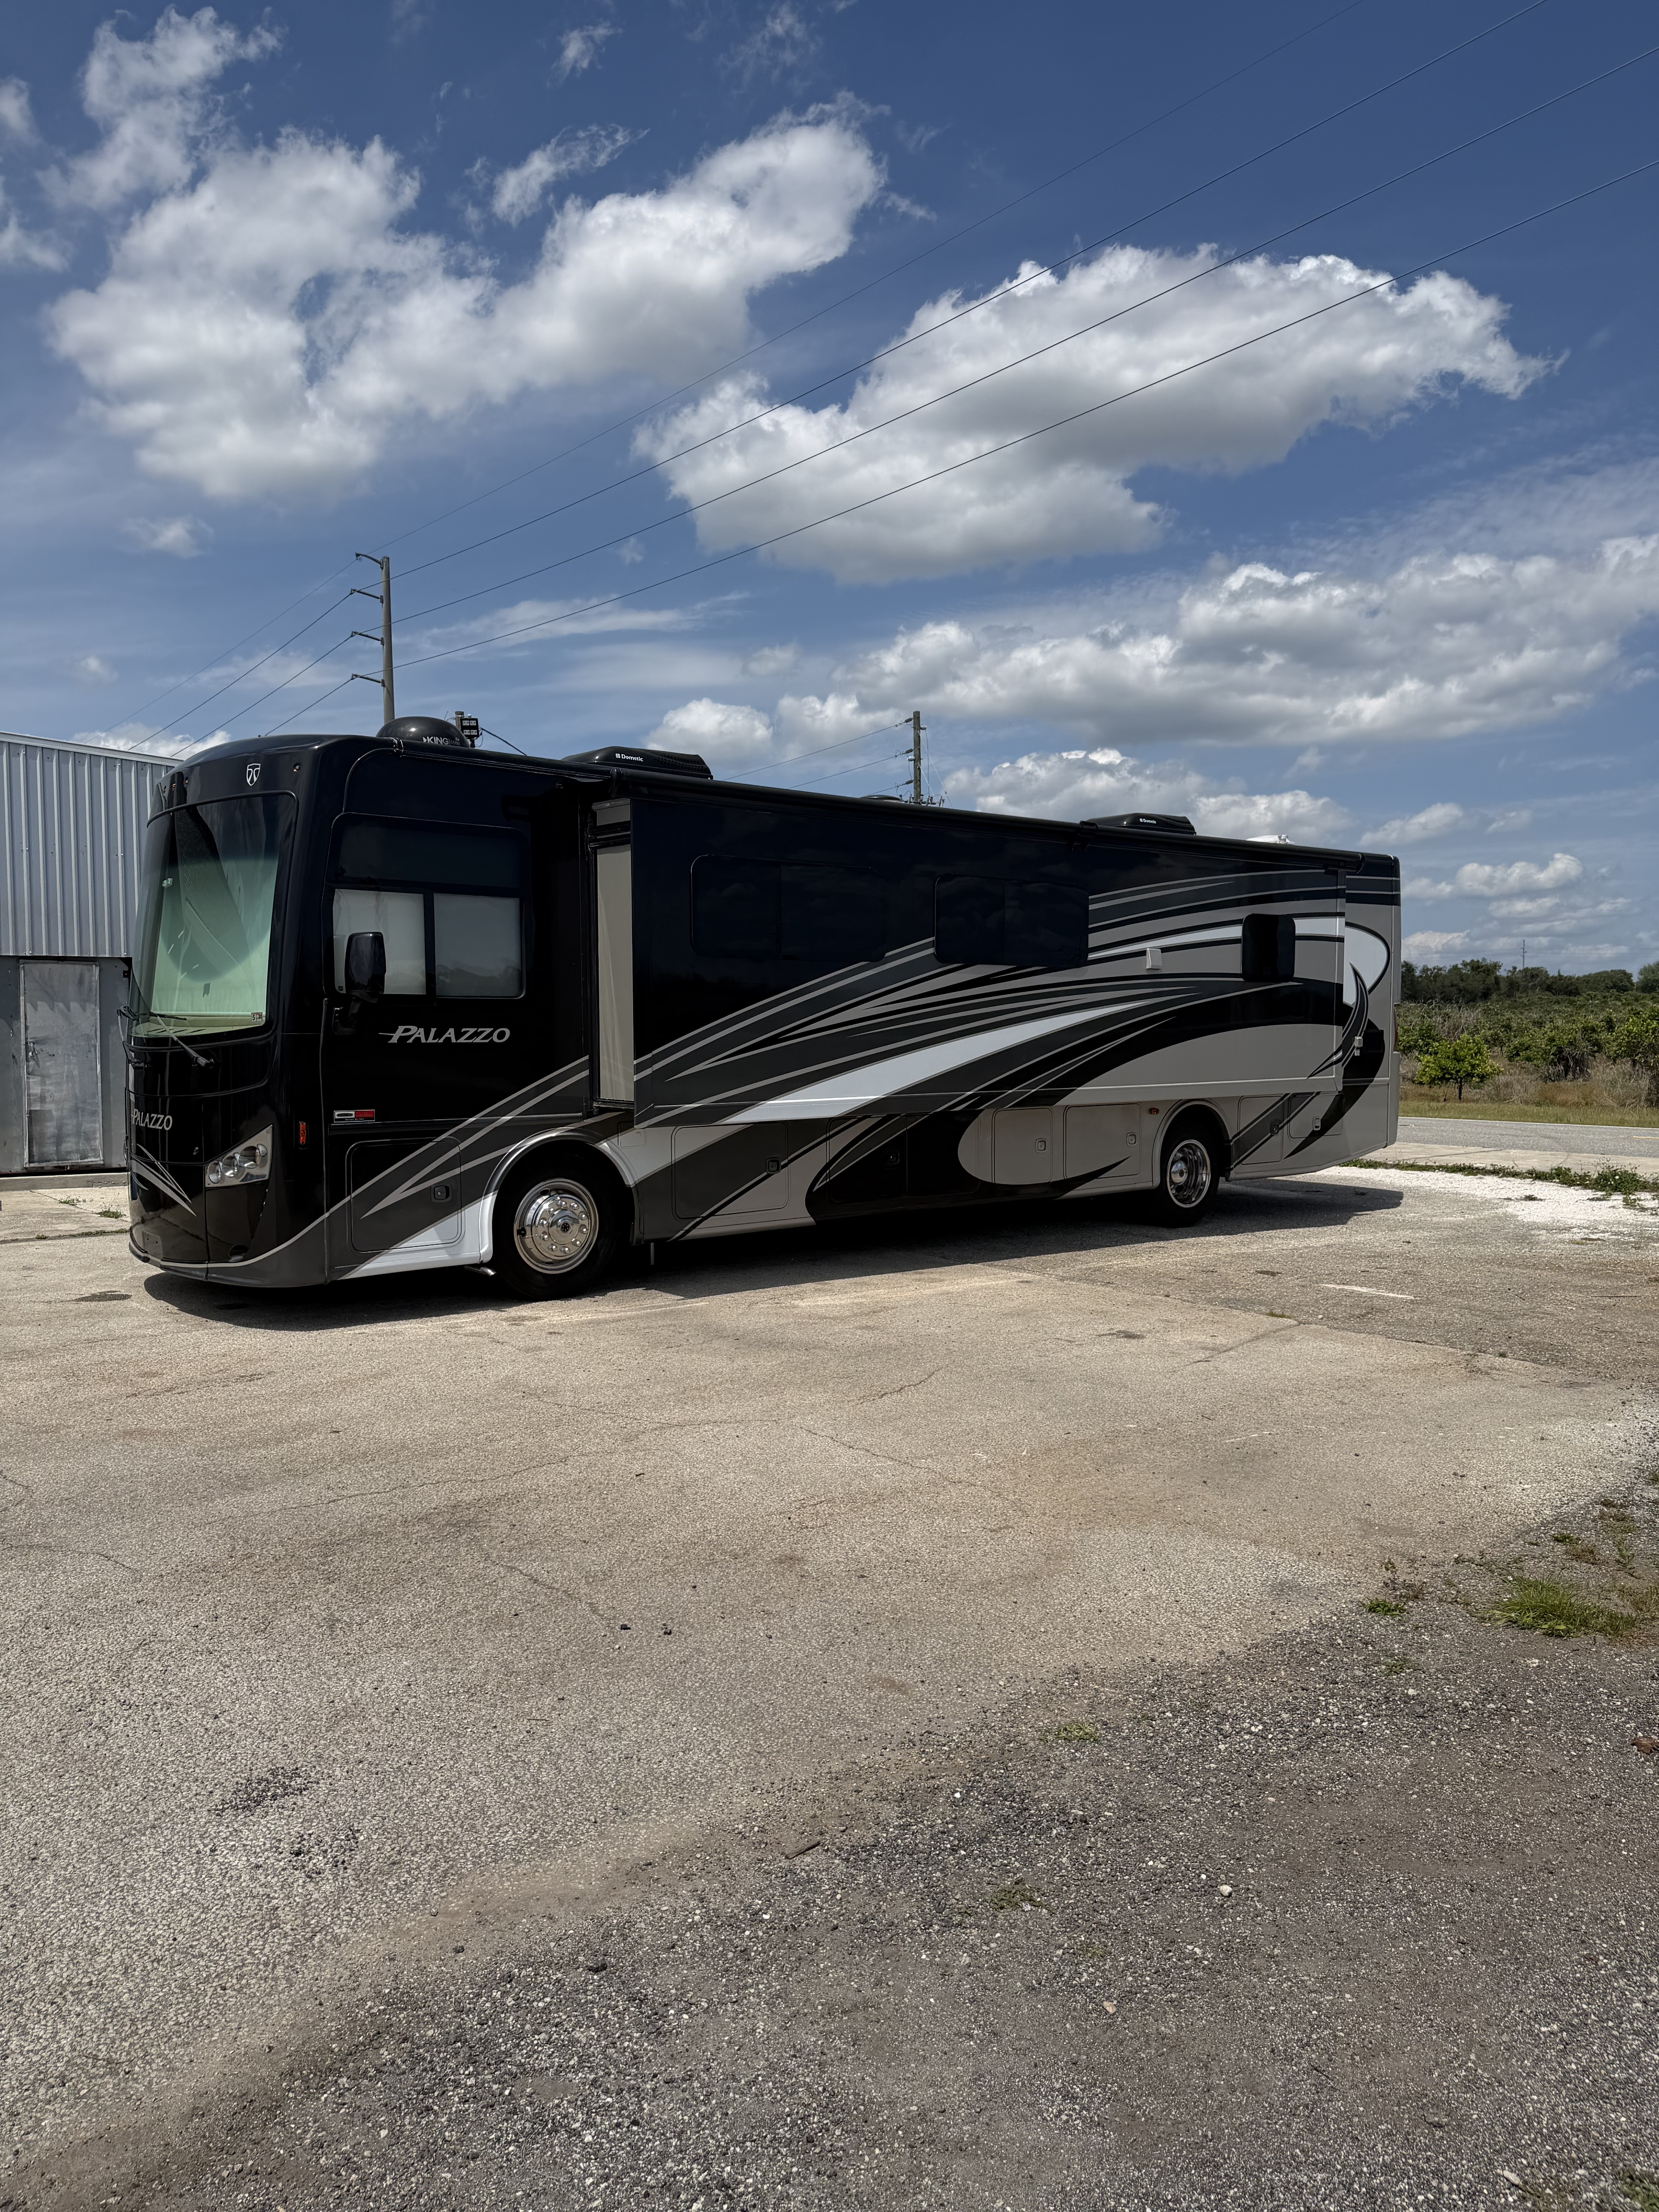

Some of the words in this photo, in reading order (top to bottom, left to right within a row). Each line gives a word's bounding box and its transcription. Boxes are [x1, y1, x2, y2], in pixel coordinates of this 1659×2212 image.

[427, 736, 449, 745] KING
[621, 754, 644, 762] Dometic
[379, 1025, 510, 1043] PALAZZO
[131, 1108, 173, 1131] PALAZZO
